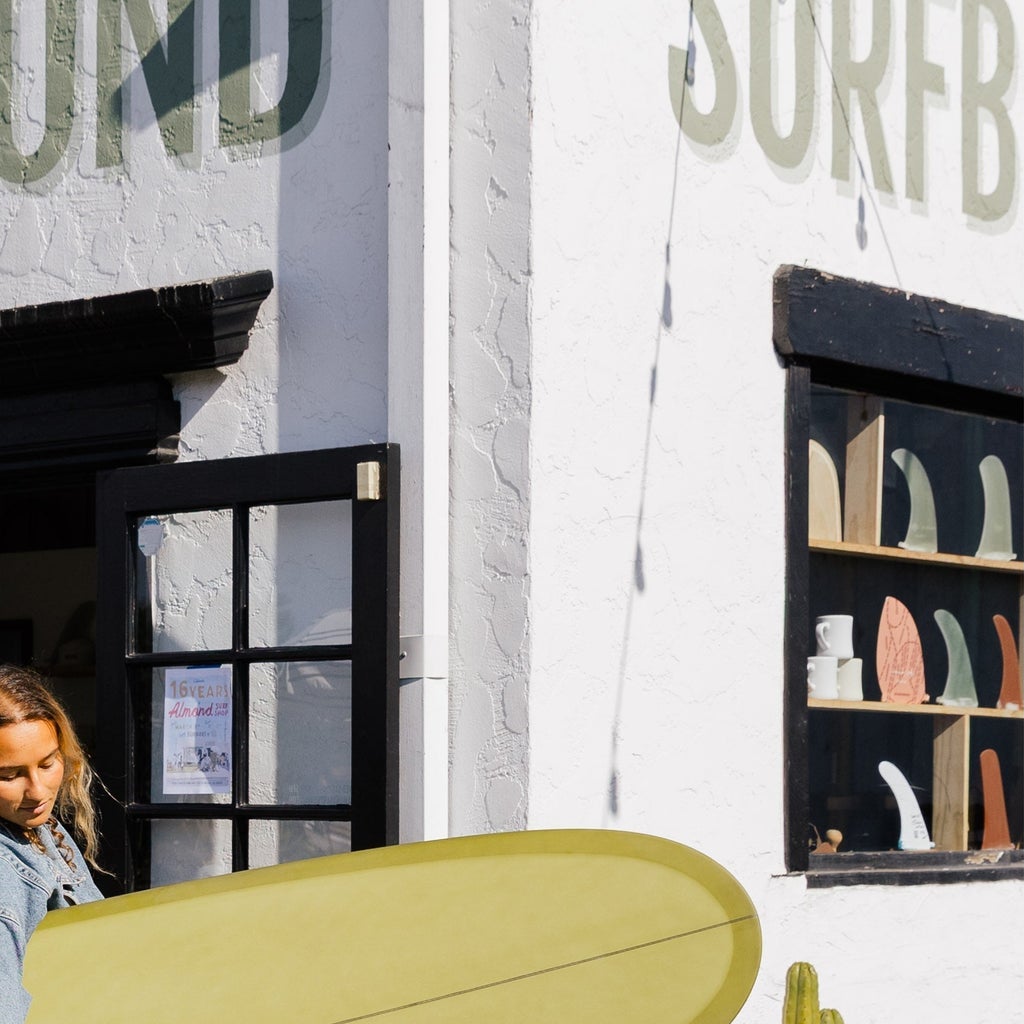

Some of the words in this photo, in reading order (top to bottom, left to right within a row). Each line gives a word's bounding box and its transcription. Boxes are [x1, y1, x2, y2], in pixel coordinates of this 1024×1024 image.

[170, 680, 188, 699] 16
[189, 685, 229, 699] YEARS
[168, 701, 214, 718] Almond
